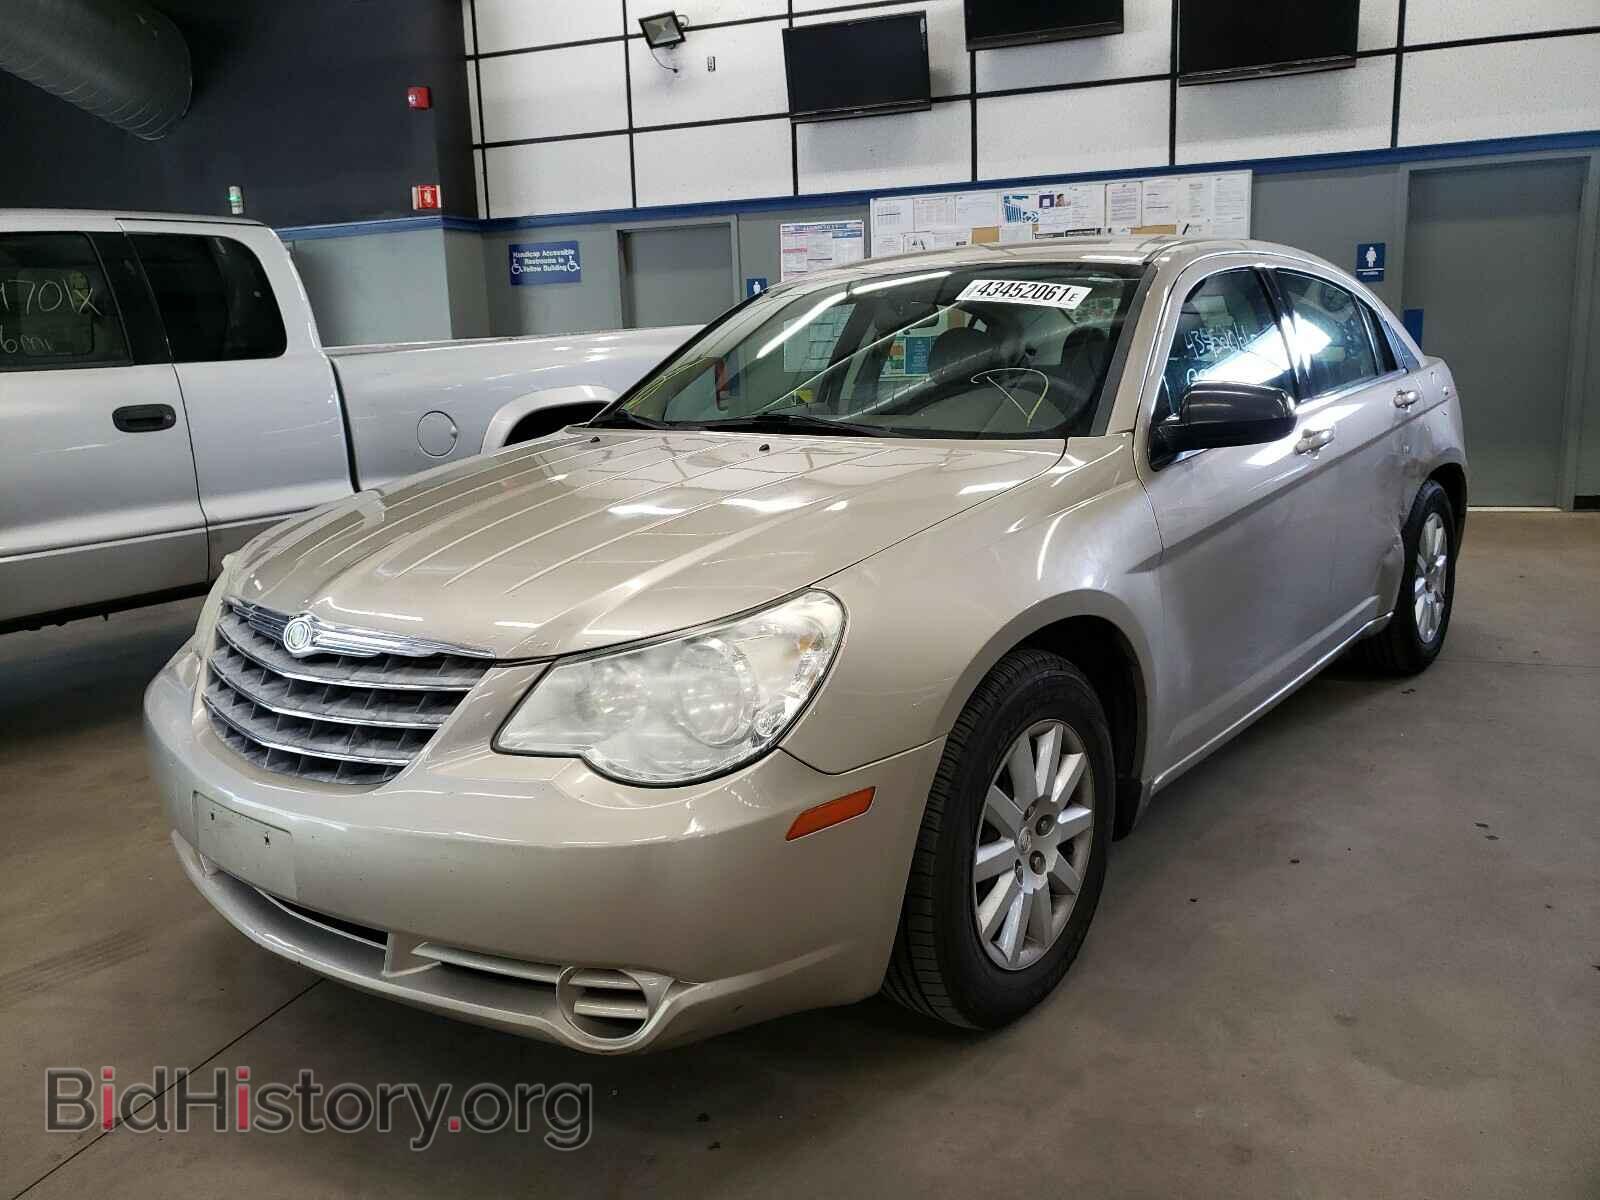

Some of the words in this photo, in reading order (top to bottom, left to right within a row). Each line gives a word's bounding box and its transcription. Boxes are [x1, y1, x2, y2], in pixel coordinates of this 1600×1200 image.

[542, 248, 575, 256] Accessible
[543, 264, 567, 272] Building
[977, 281, 1072, 303] 43452061
[1068, 293, 1079, 302] E
